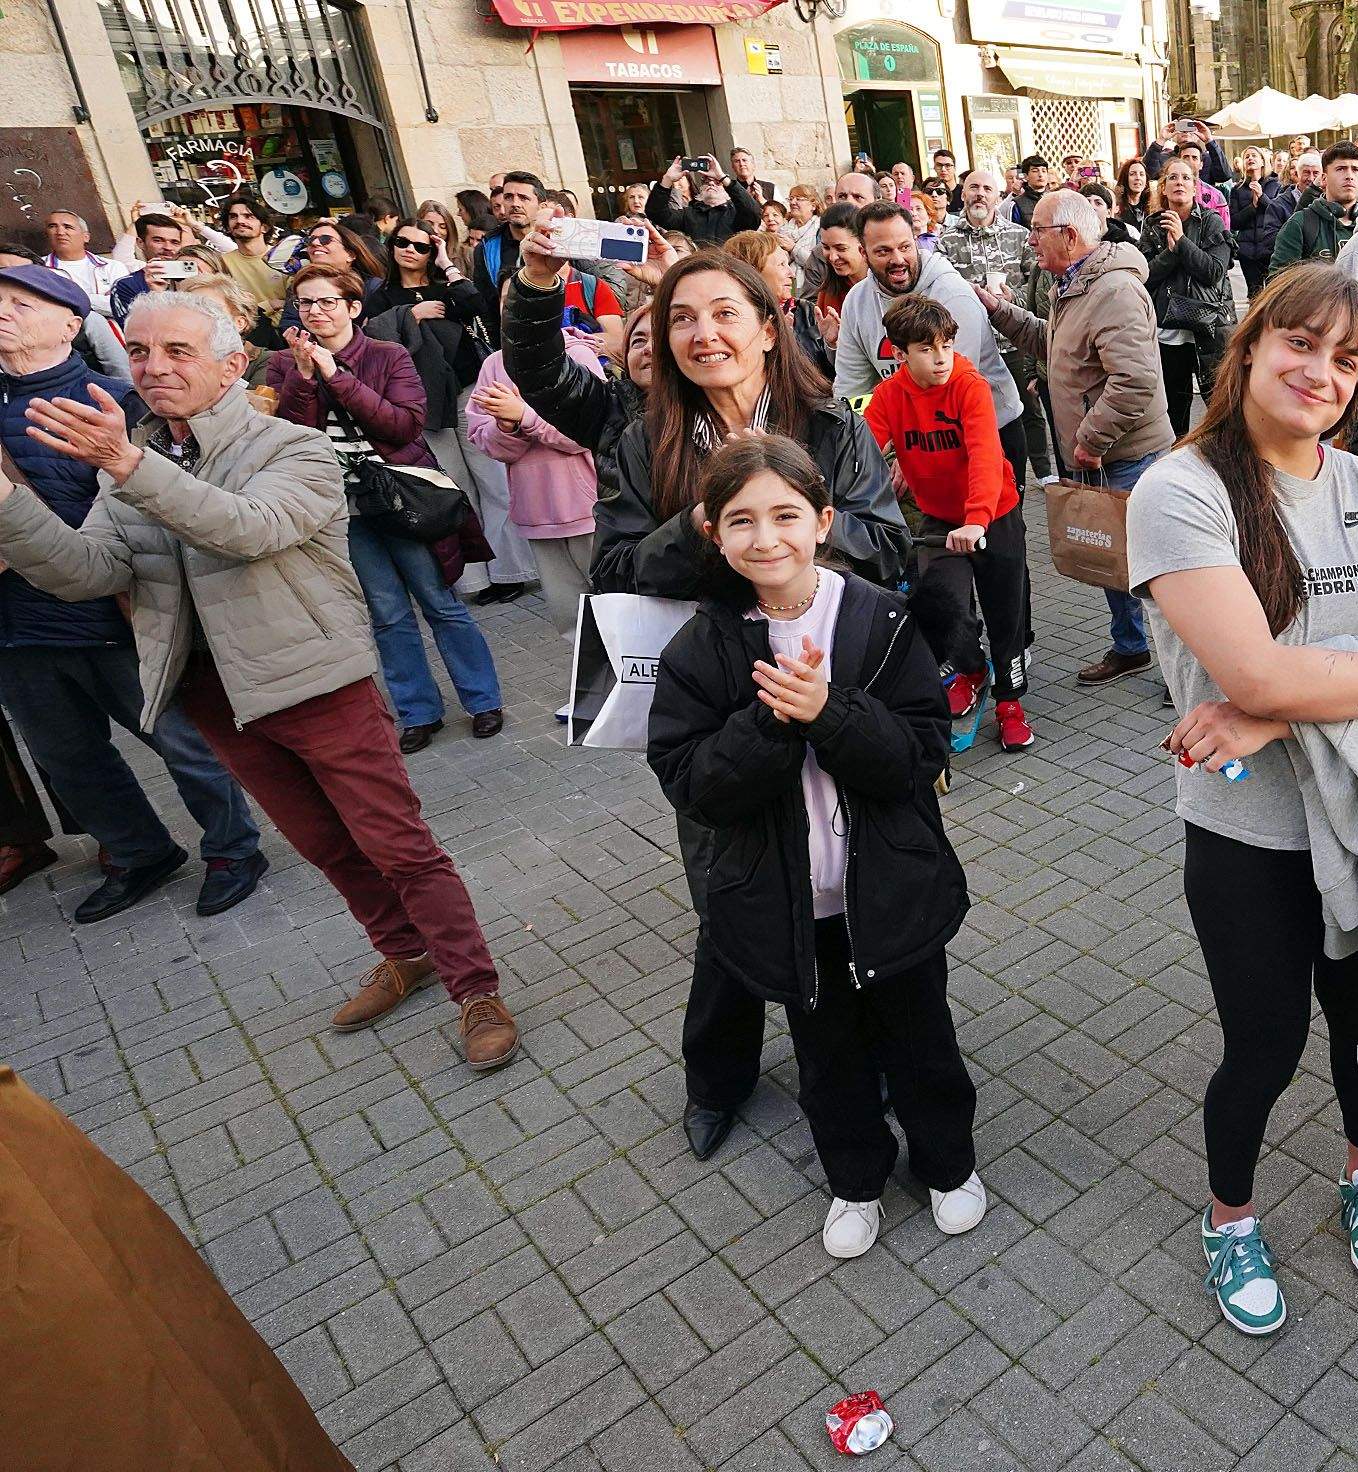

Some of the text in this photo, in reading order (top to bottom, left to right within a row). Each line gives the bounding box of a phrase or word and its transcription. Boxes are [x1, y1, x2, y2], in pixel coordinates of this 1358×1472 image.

[854, 41, 919, 54] PLAZA DE ESPAÑA
[605, 62, 682, 79] TABACOS
[165, 138, 255, 162] FARMACIA
[904, 429, 961, 452] PUMA
